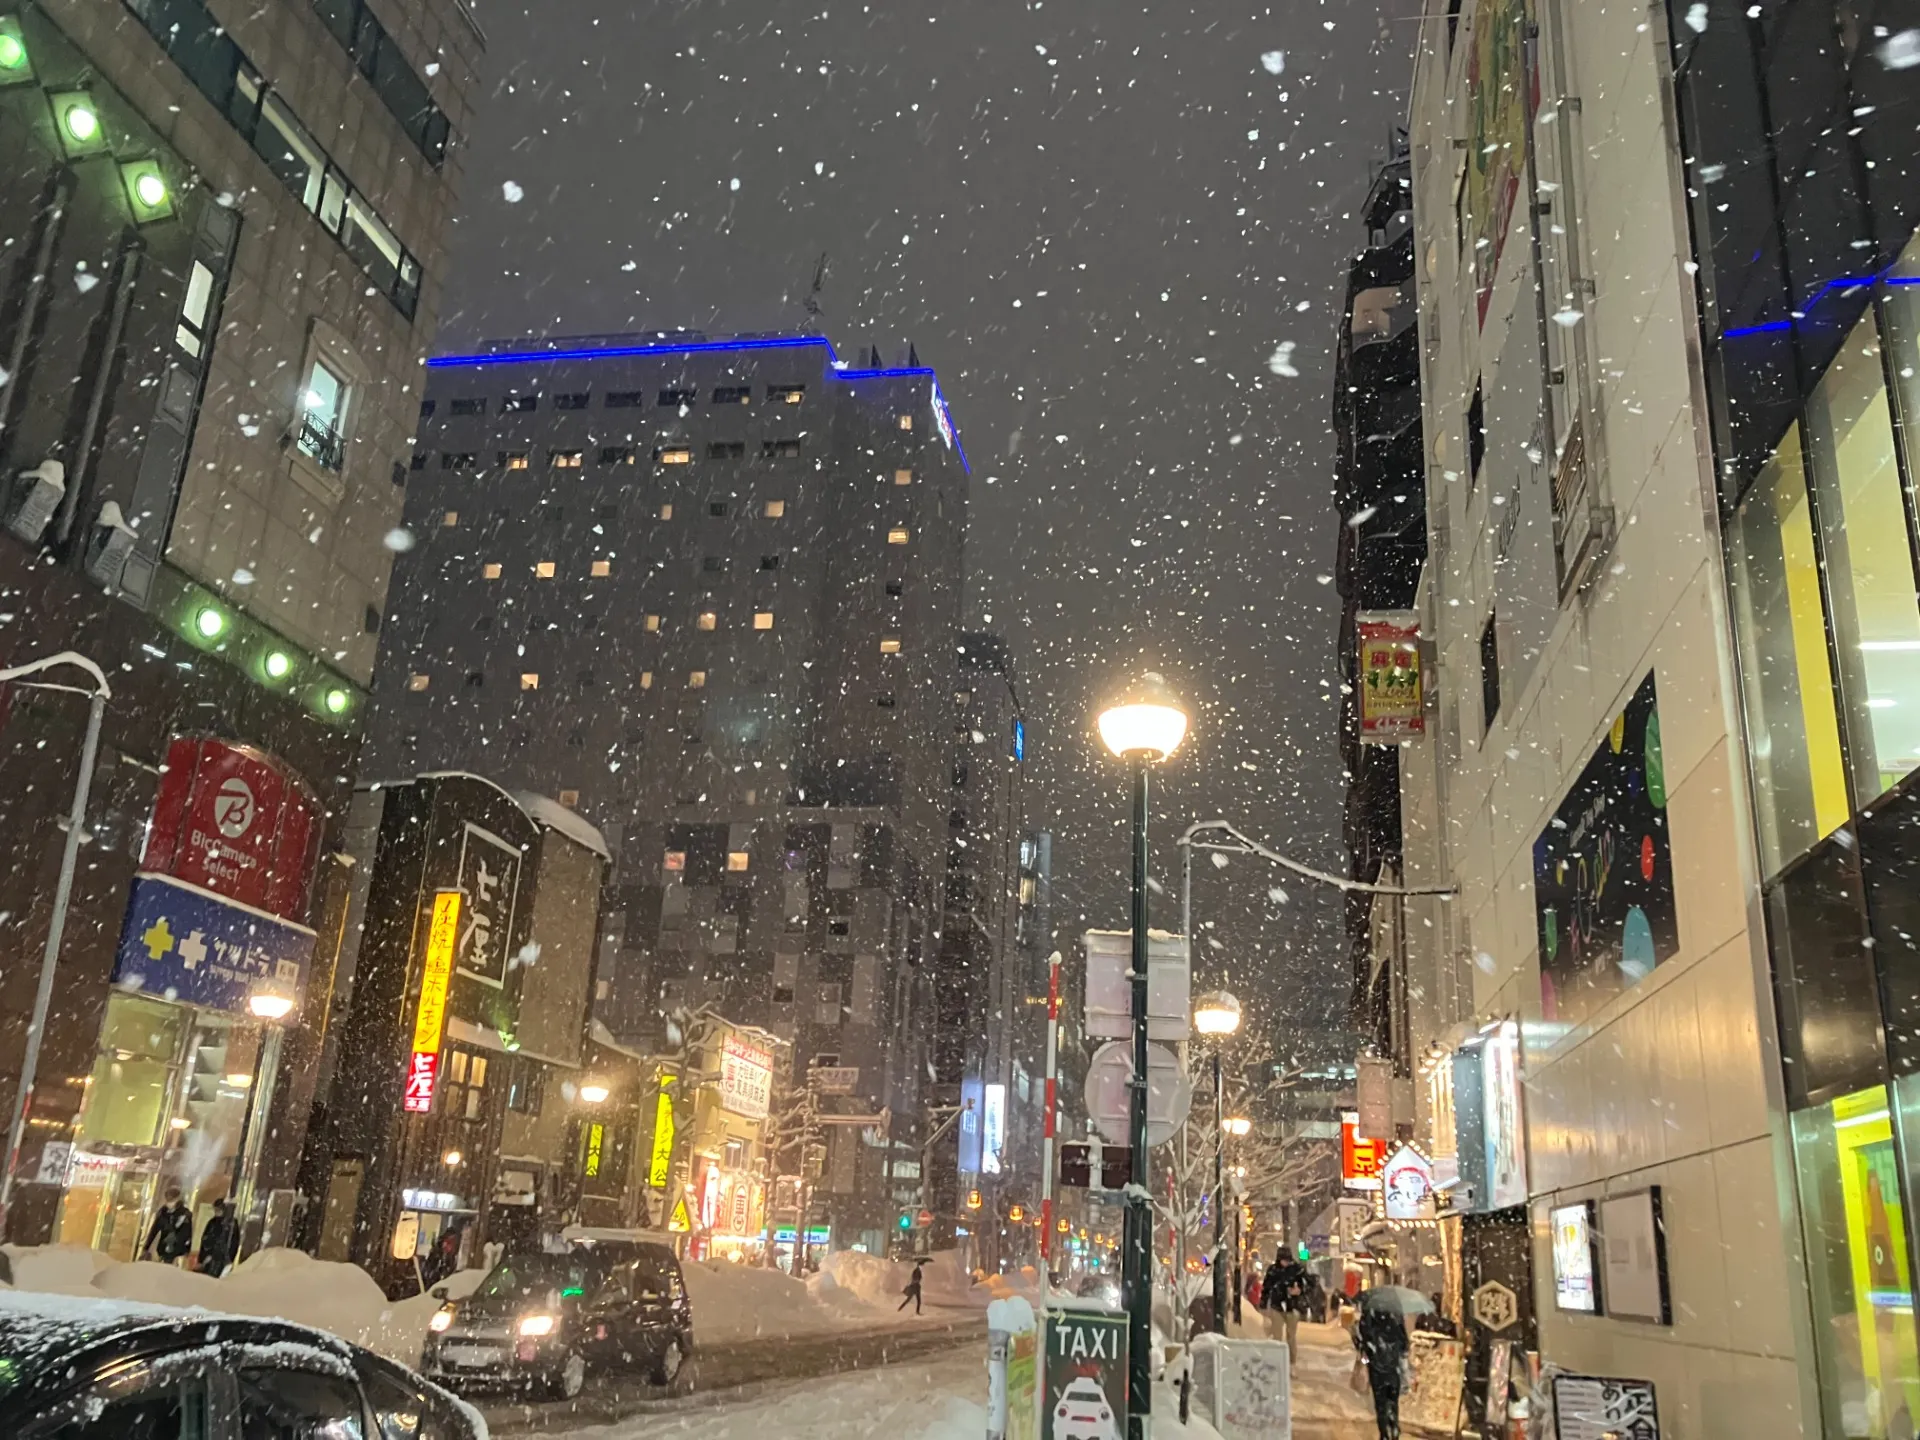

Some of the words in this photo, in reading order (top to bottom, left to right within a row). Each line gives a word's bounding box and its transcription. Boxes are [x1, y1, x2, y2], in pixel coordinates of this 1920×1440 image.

[190, 828, 258, 870] BicCamera
[202, 856, 240, 883] Select
[1055, 1325, 1118, 1360] TAXI
